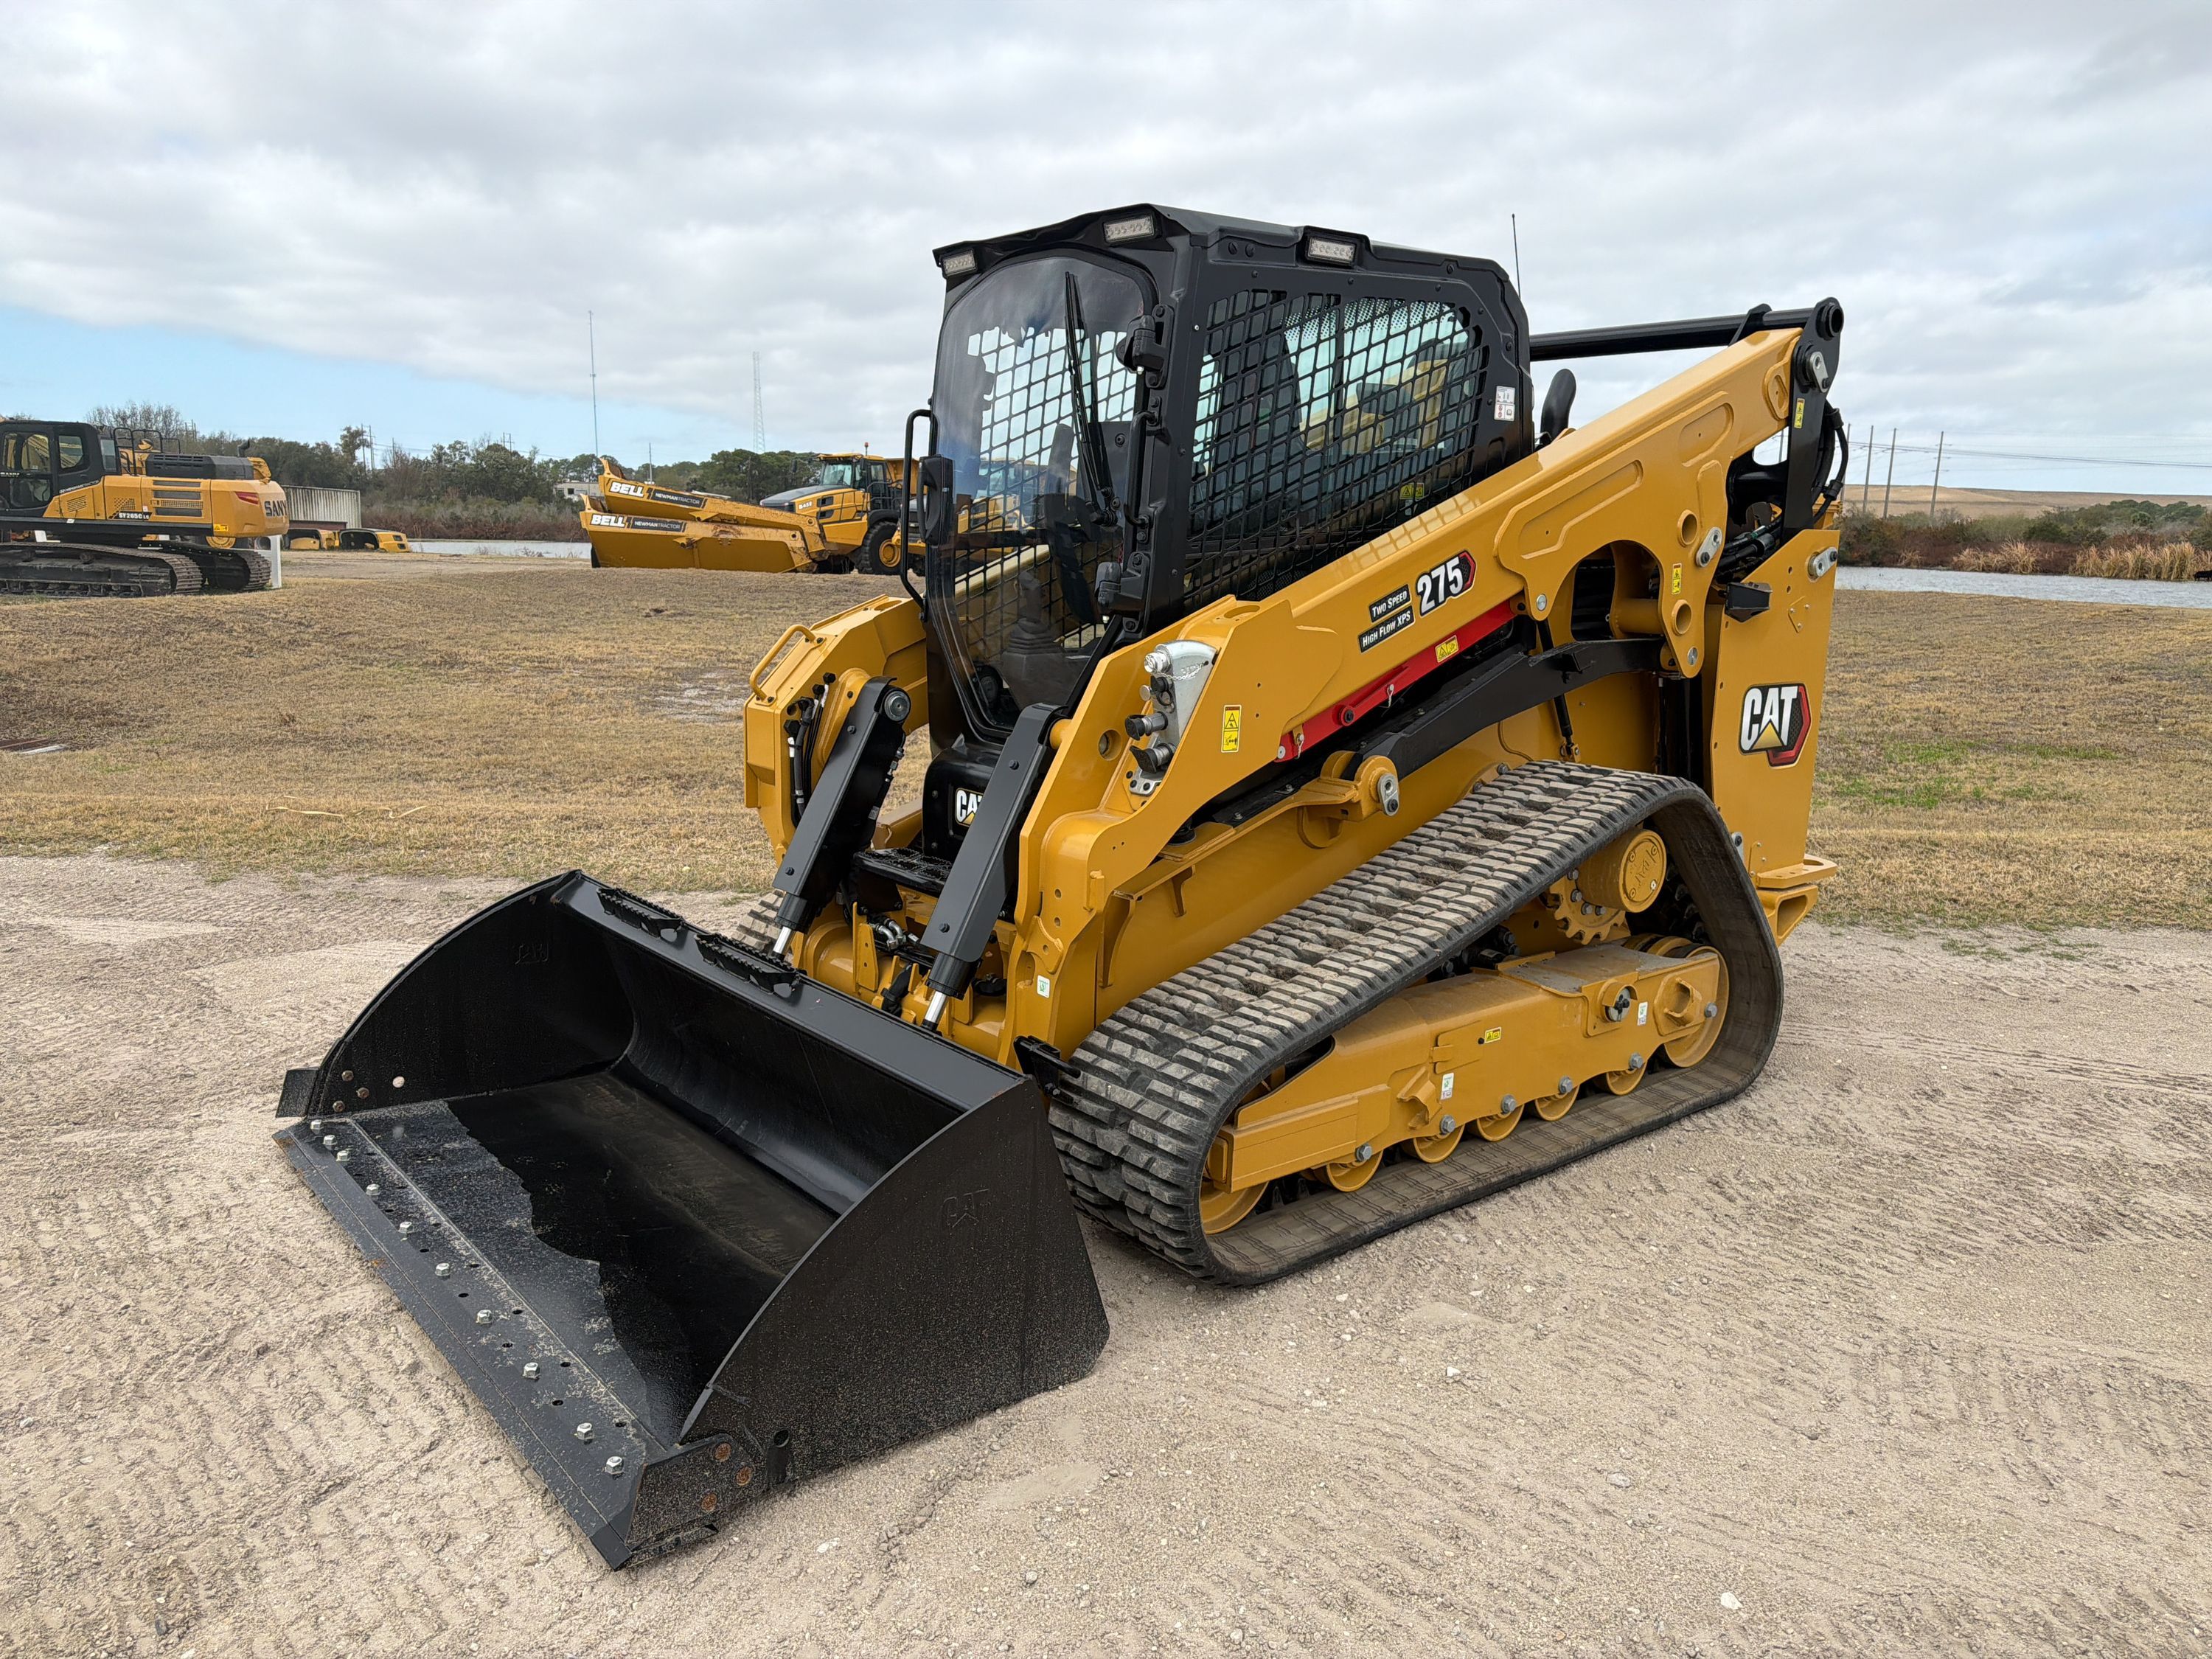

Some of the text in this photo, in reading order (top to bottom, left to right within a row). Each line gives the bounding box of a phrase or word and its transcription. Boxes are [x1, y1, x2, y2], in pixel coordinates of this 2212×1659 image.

[610, 481, 644, 498] BELL
[264, 501, 287, 517] SANY
[591, 514, 625, 527] BELL
[1416, 556, 1464, 613] 275
[1371, 604, 1387, 618] TWO
[1397, 610, 1411, 626] XPS
[1740, 686, 1798, 751] CAT
